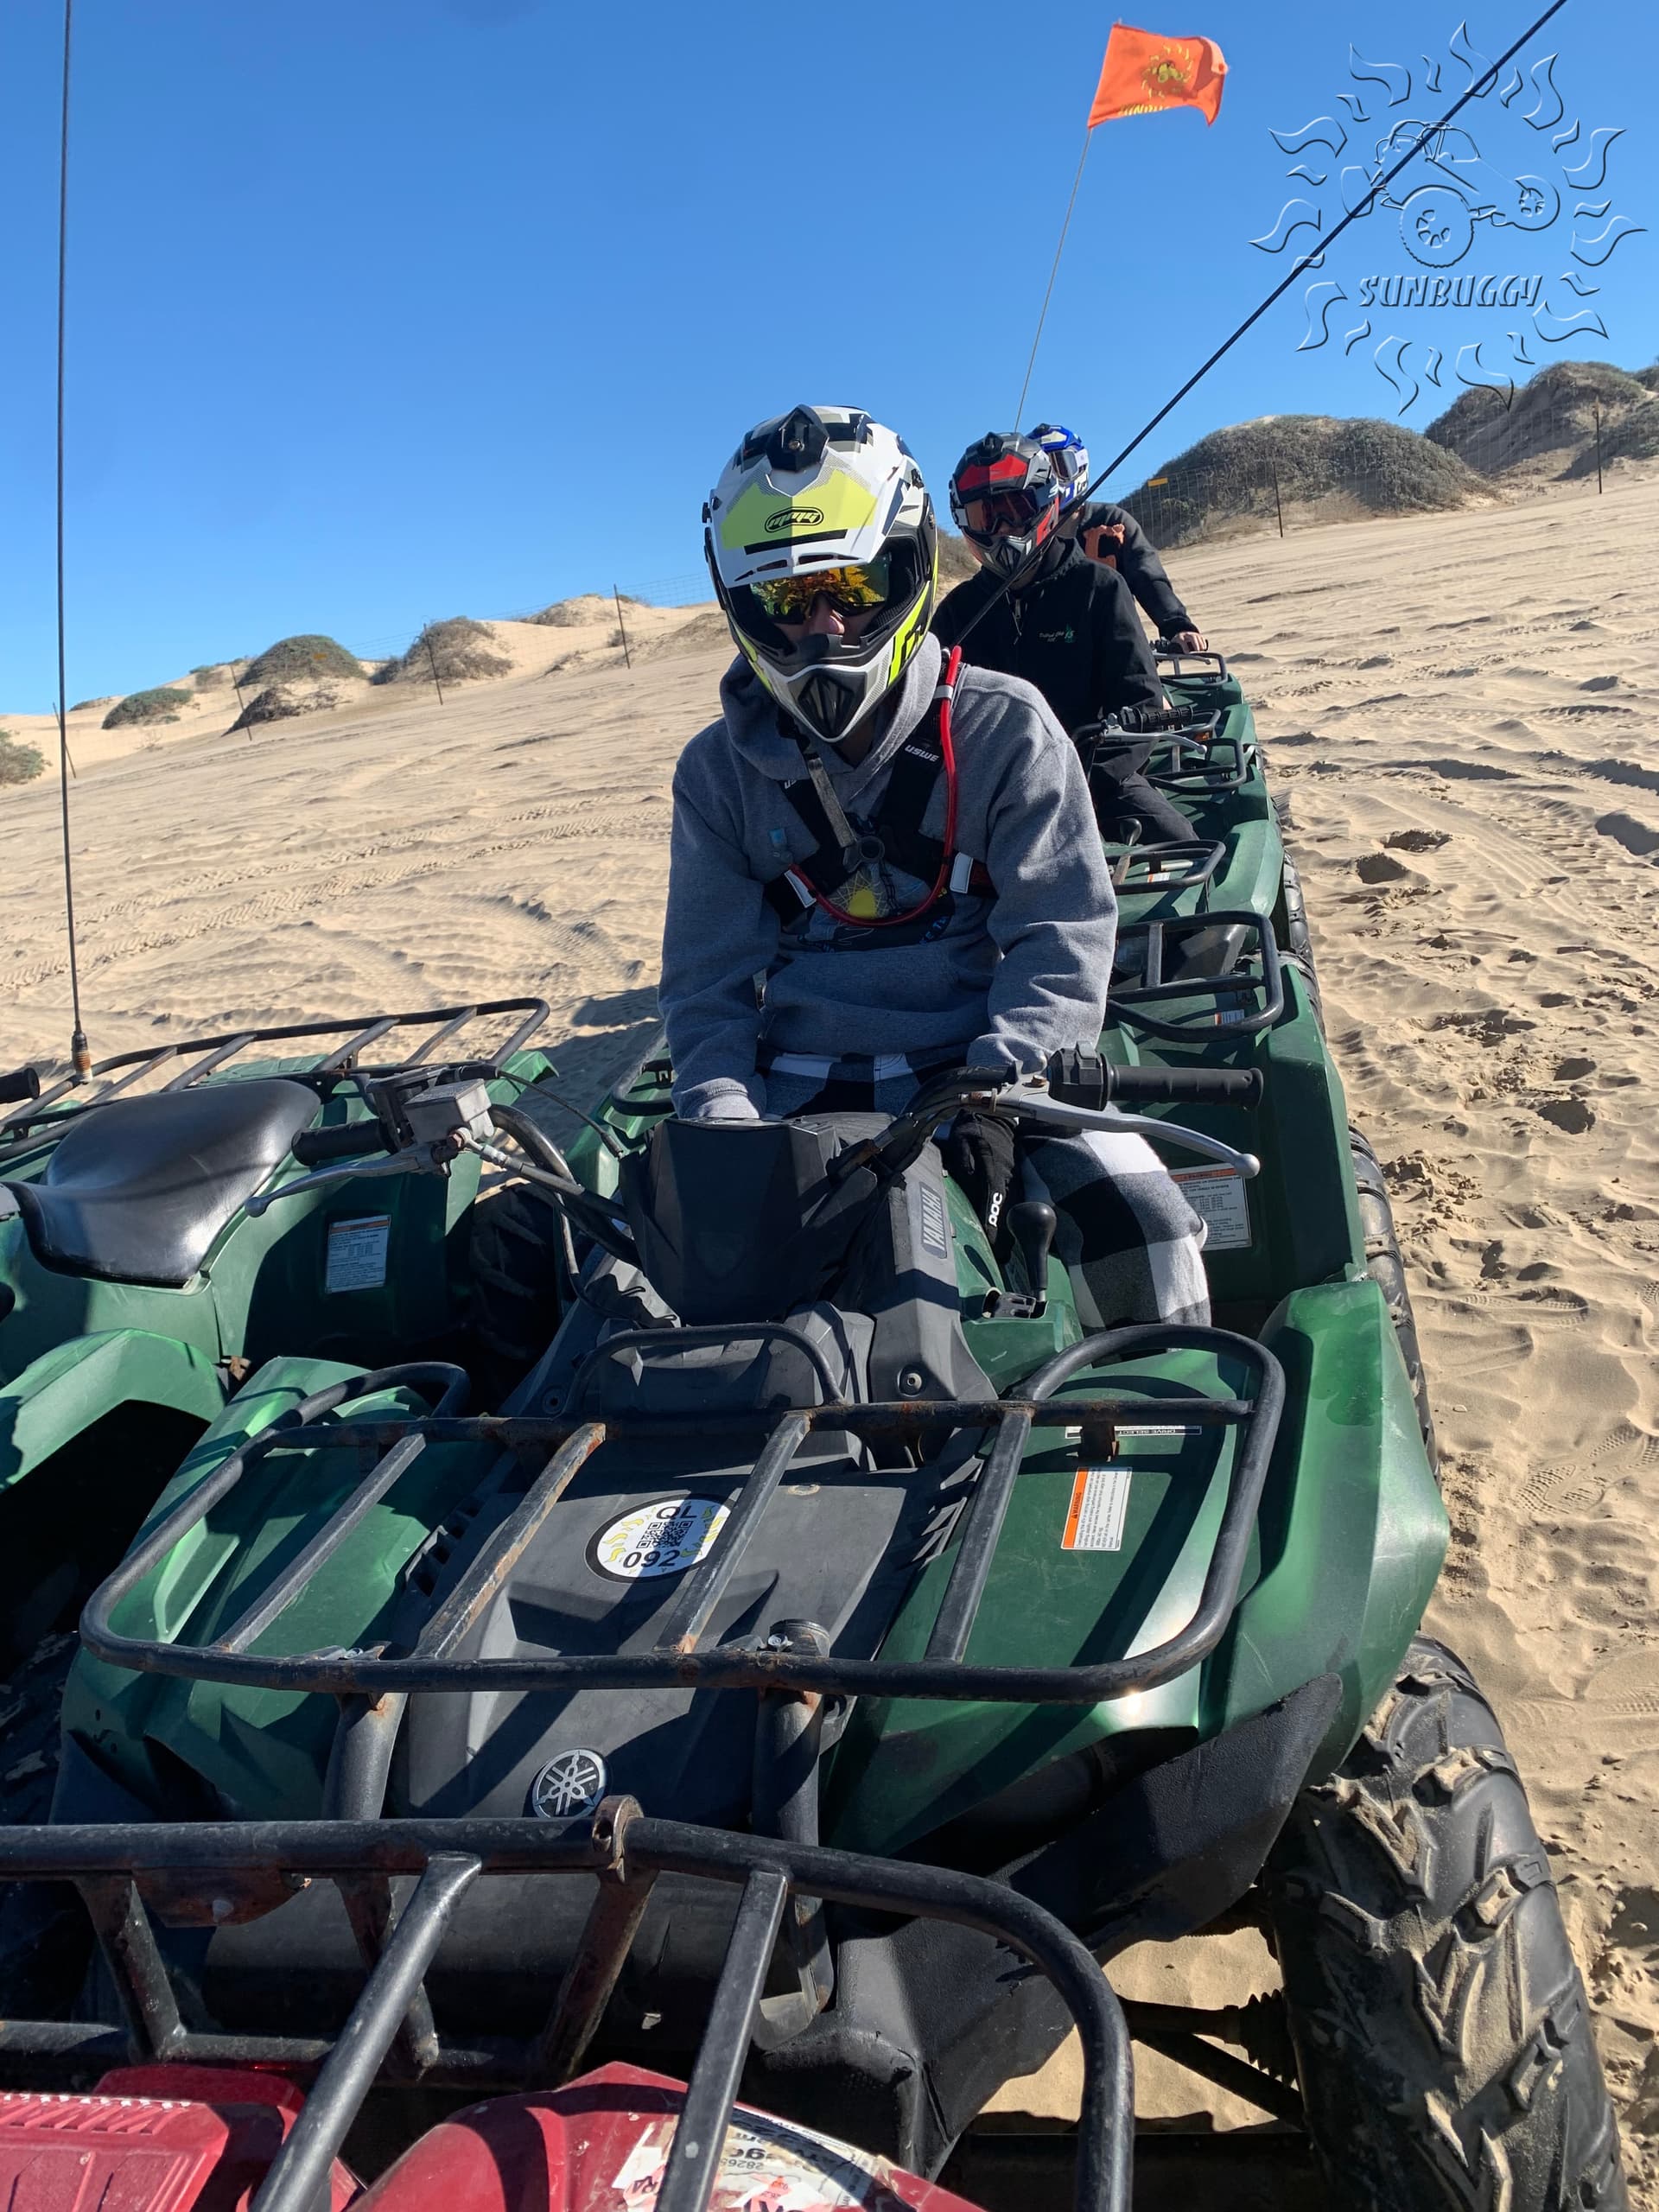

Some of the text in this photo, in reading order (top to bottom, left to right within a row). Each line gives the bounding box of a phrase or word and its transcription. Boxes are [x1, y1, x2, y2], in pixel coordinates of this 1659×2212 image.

[904, 744, 939, 762] USWE
[921, 1187, 945, 1252] YAMAHA
[656, 1504, 698, 1521] QL
[622, 1549, 682, 1569] 092
